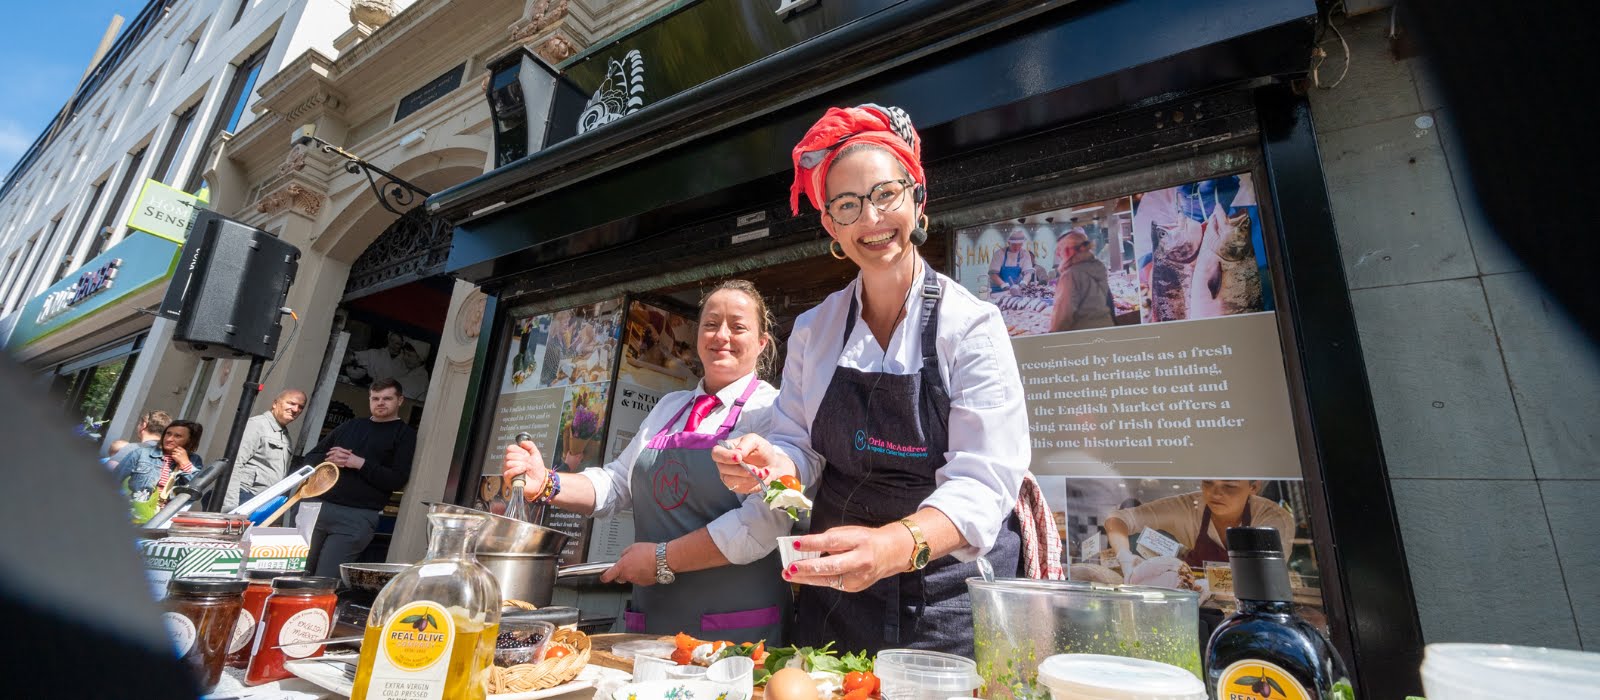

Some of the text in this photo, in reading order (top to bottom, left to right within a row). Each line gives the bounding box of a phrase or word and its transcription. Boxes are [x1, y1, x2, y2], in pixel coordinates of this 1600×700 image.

[144, 206, 194, 230] SENSE
[1022, 345, 1232, 370] recognised by locals as a fresh
[1030, 374, 1079, 384] market,
[1082, 374, 1089, 382] a
[1093, 369, 1151, 380] heritage
[1028, 380, 1228, 400] and meeting place to eat and
[621, 399, 630, 407] &
[1034, 400, 1230, 416] the English Market offers a
[1029, 416, 1244, 434] sing range of Irish food under
[869, 437, 928, 452] Orla McAndrew
[1056, 439, 1080, 448] one
[1084, 436, 1152, 448] historical
[1156, 435, 1194, 447] roof.
[660, 473, 678, 494] M
[391, 632, 444, 642] REAL OLIVE
